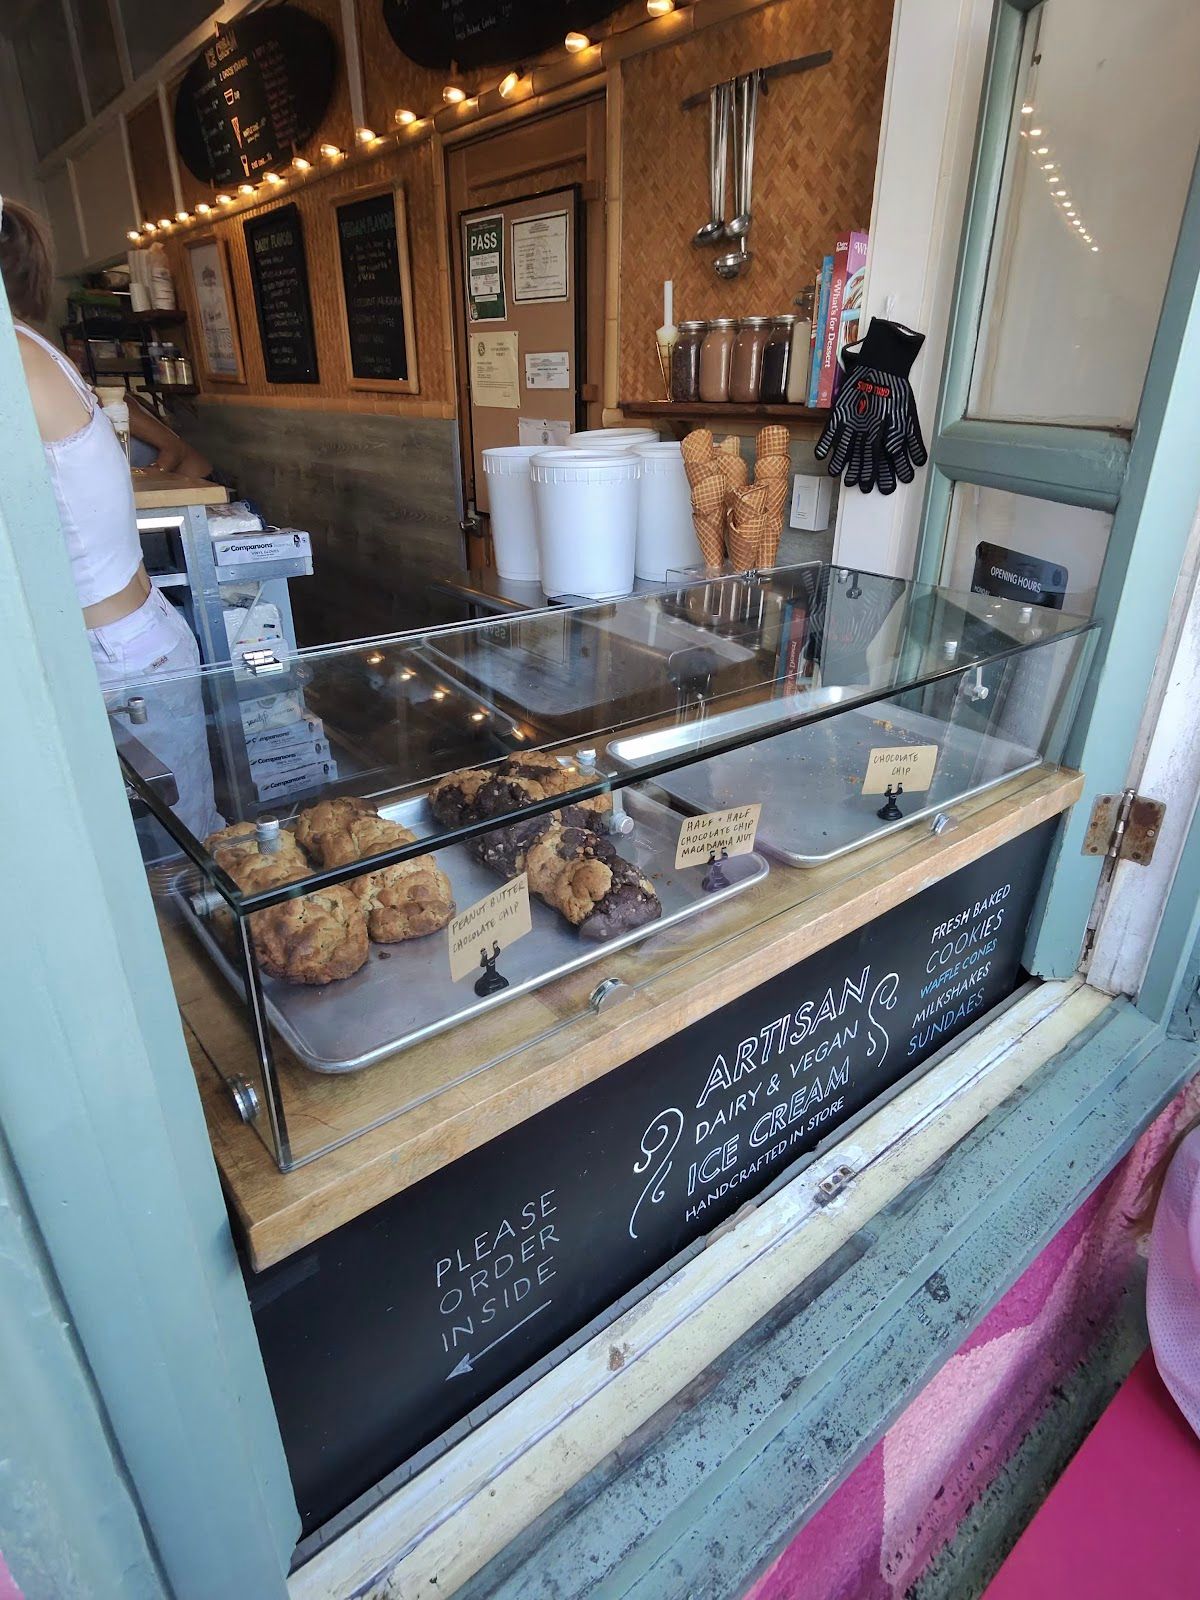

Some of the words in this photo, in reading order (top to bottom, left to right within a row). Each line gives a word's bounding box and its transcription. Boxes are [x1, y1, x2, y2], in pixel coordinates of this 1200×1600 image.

[471, 231, 497, 251] PASS
[830, 278, 842, 317] What's
[829, 317, 838, 329] for
[825, 328, 836, 368] Dessert
[230, 543, 273, 552] Companions
[990, 566, 1017, 585] OPENING
[1017, 575, 1042, 593] HOURS
[251, 731, 290, 743] Cmpanions
[258, 753, 297, 764] Companions
[874, 752, 918, 764] CHOCOLATE
[270, 774, 307, 789] Companions
[892, 766, 911, 776] CHIP
[681, 826, 730, 846] CHOCOLATE
[733, 819, 754, 832] CHIP
[687, 819, 713, 832] HALF
[727, 808, 752, 822] HALF
[681, 837, 733, 858] MACADAMIA
[736, 833, 753, 844] NUT
[452, 903, 486, 936] PEANUT
[490, 880, 526, 907] BUTTER
[453, 918, 497, 953] CHOCOLATE
[498, 901, 519, 921] CHIP
[931, 908, 971, 944] FRESH
[973, 884, 1011, 918] BAKED
[926, 909, 1005, 974] COOKIES
[920, 962, 961, 999] WAFFLE
[962, 938, 998, 970] CONES
[912, 961, 992, 1029] MILKSHAKES
[696, 965, 871, 1109] ARTISAN
[907, 987, 985, 1056] SUNDAES
[696, 1082, 762, 1145] DAIRY
[766, 1073, 780, 1096] &
[790, 1020, 859, 1079] VEGAN
[687, 1134, 740, 1197] ICE
[749, 1056, 850, 1148] CREAM
[686, 1140, 787, 1223] HANDCRAFTED
[790, 1126, 804, 1146] IN
[807, 1096, 846, 1132] STORE
[436, 1189, 557, 1288] PLEASE
[439, 1224, 560, 1314] ORDER
[442, 1255, 557, 1352] INSIDE
